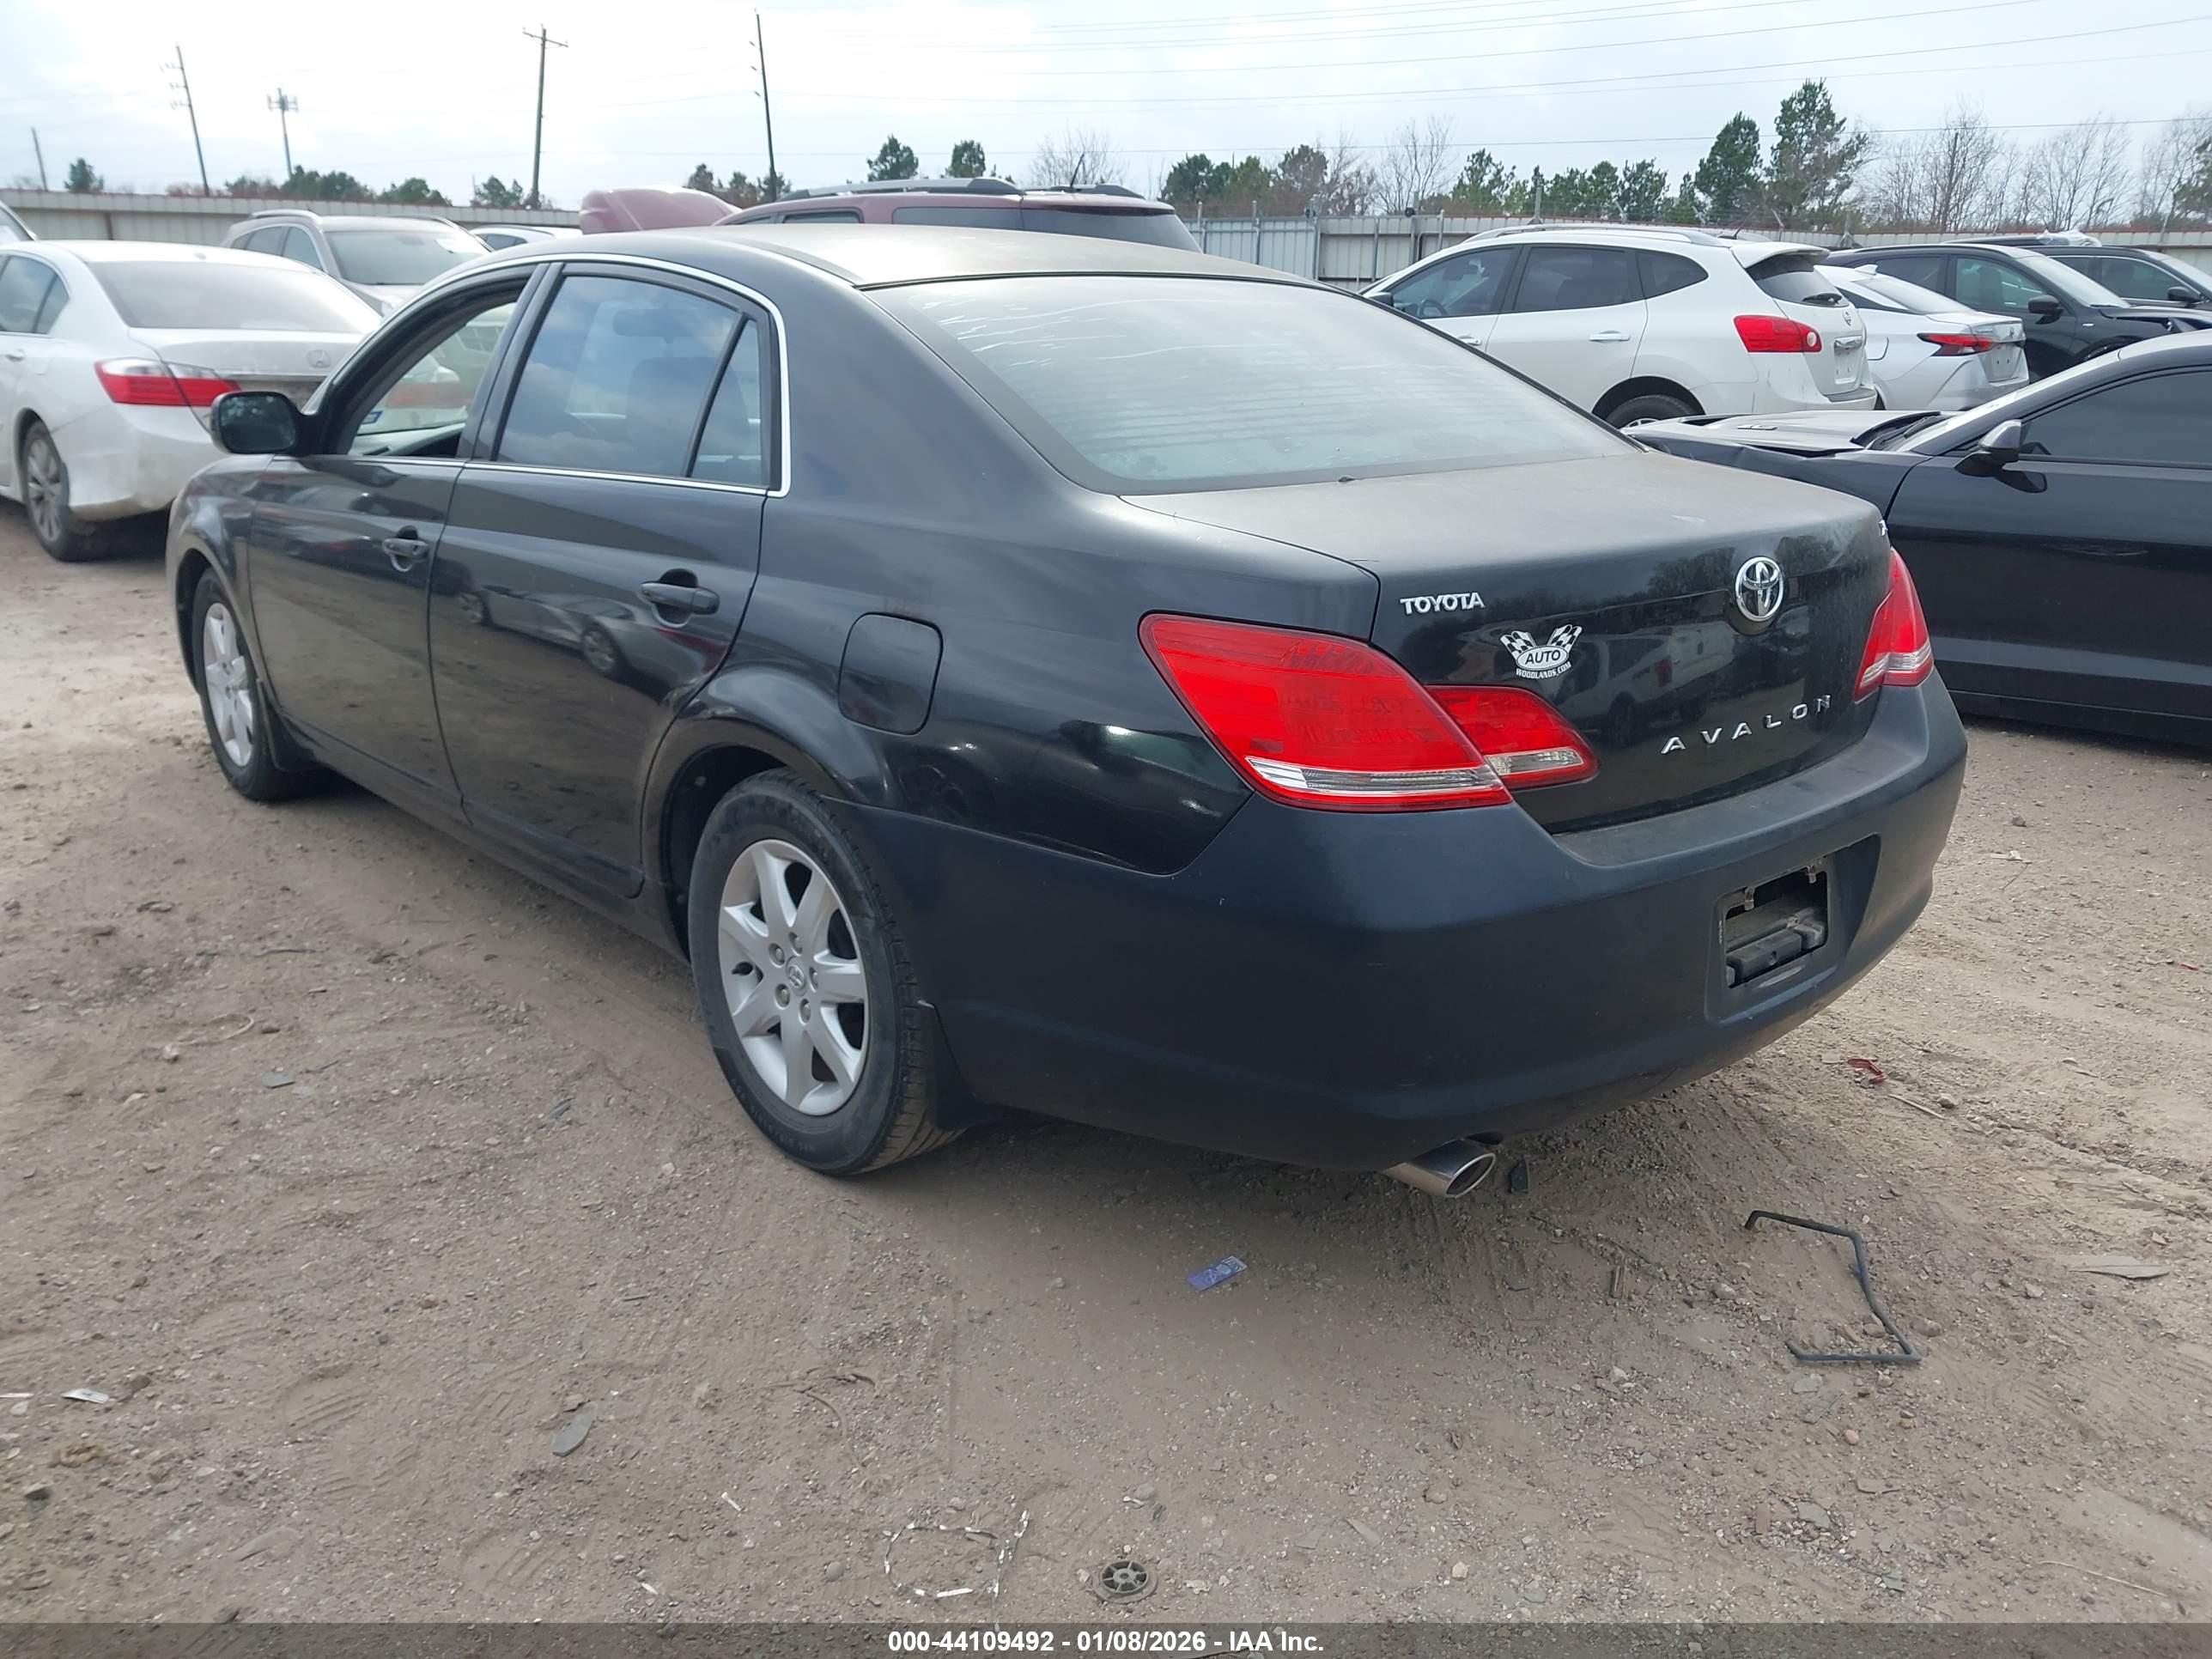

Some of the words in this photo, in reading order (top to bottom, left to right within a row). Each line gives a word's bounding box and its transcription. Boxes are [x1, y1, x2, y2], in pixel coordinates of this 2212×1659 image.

[1400, 592, 1486, 615] TOYOTA
[1524, 649, 1561, 665] AUTO
[1515, 660, 1572, 680] WOODLANDS.COM
[1660, 694, 1832, 755] AVALON
